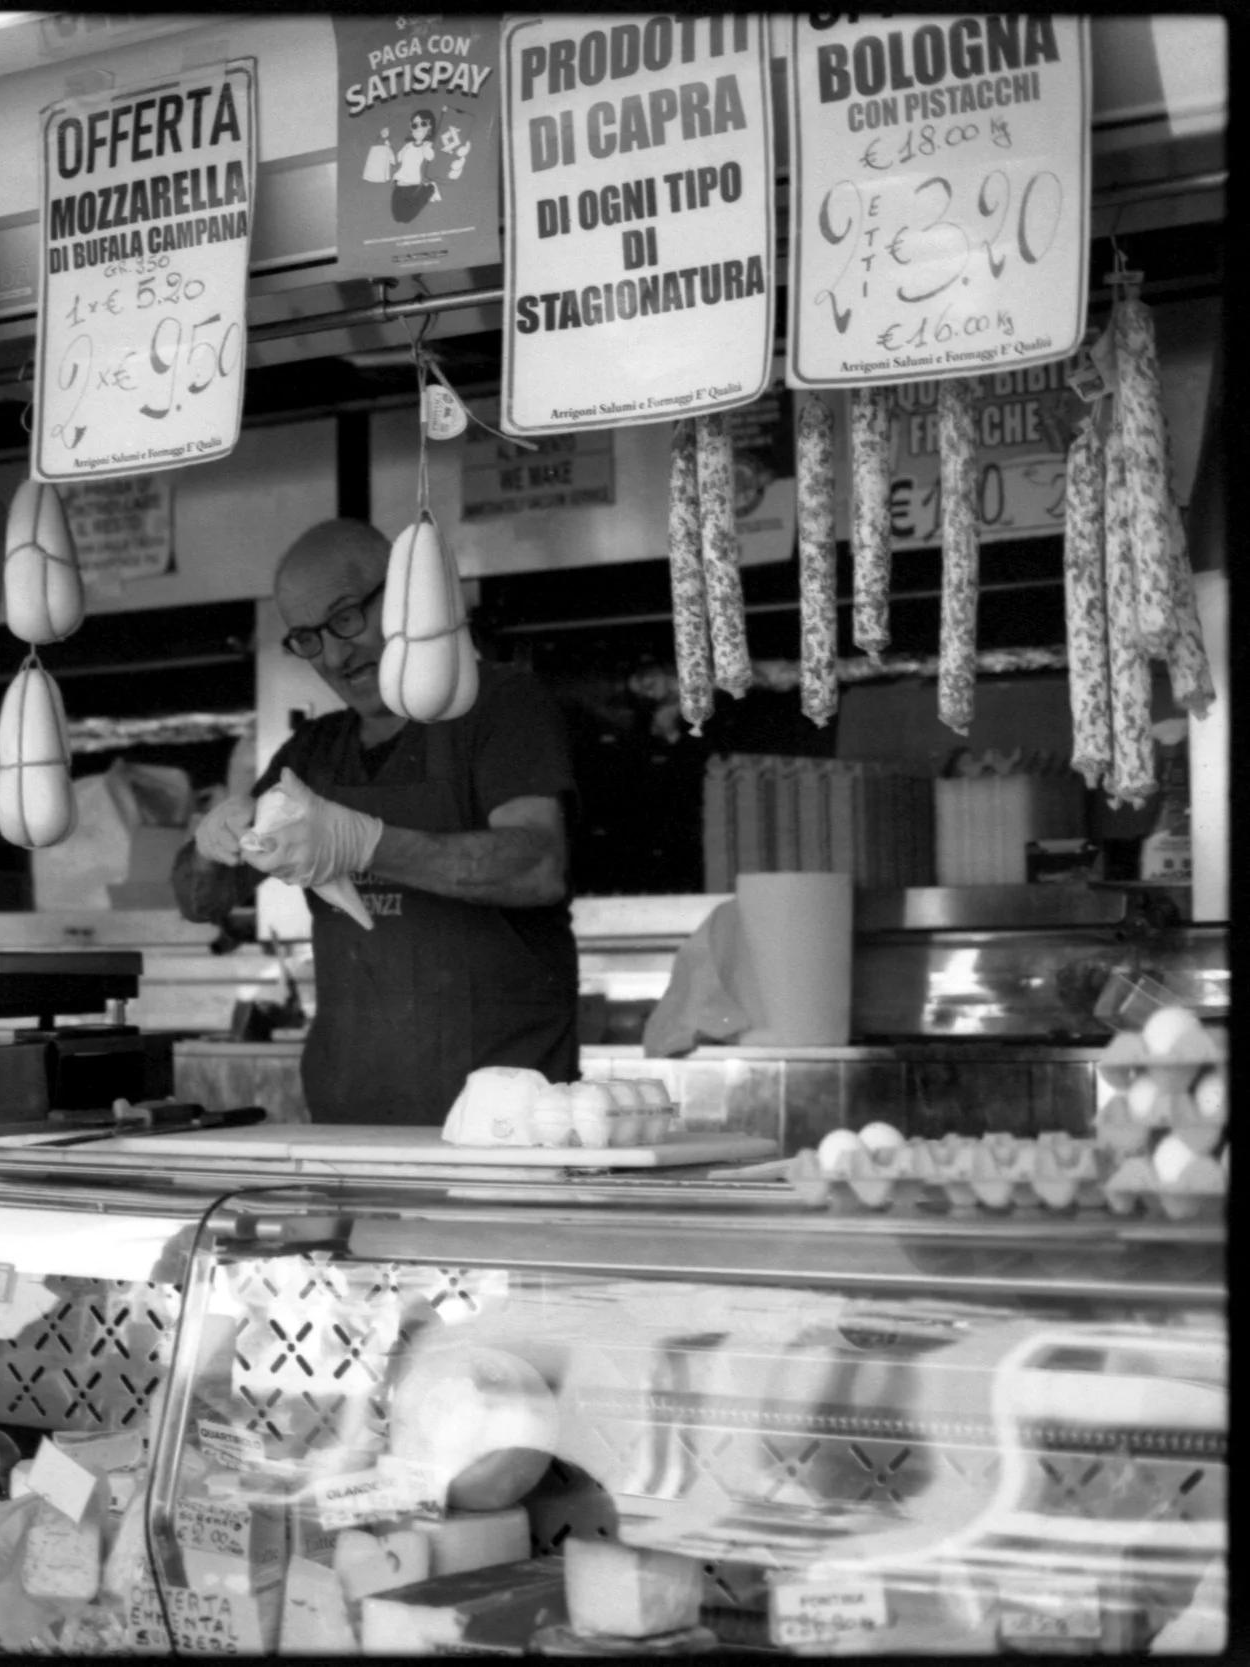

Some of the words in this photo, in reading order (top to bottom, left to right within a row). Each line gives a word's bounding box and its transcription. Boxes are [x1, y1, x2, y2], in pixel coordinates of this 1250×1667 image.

[367, 36, 423, 71] PAGA
[426, 33, 471, 57] CON
[521, 14, 748, 101] PRODOTTI
[816, 14, 1060, 104] BOLOGNA
[345, 60, 493, 115] SATISPAY
[847, 97, 899, 133] CON
[904, 71, 1041, 123] PISTACCHI
[56, 81, 241, 180] OFFERTA
[528, 108, 576, 172] DI
[586, 74, 747, 160] CAPRA
[49, 159, 247, 241] MOZZARELLA
[536, 195, 571, 239] DI
[577, 176, 657, 231] OGNI
[663, 161, 742, 213] TIPO
[49, 245, 69, 275] DI
[72, 232, 144, 270] BUFALA
[148, 210, 248, 256] CAMPANA
[621, 226, 658, 271] DI
[516, 255, 765, 335] STAGIONATURA
[840, 357, 891, 374] Arrigoni
[893, 353, 933, 368] Salumi
[945, 346, 998, 364] Formaggi
[550, 405, 597, 421] Arrigoni
[599, 400, 637, 414] Salumi
[647, 392, 694, 407] Formaggi
[73, 457, 109, 469] Arrigoni
